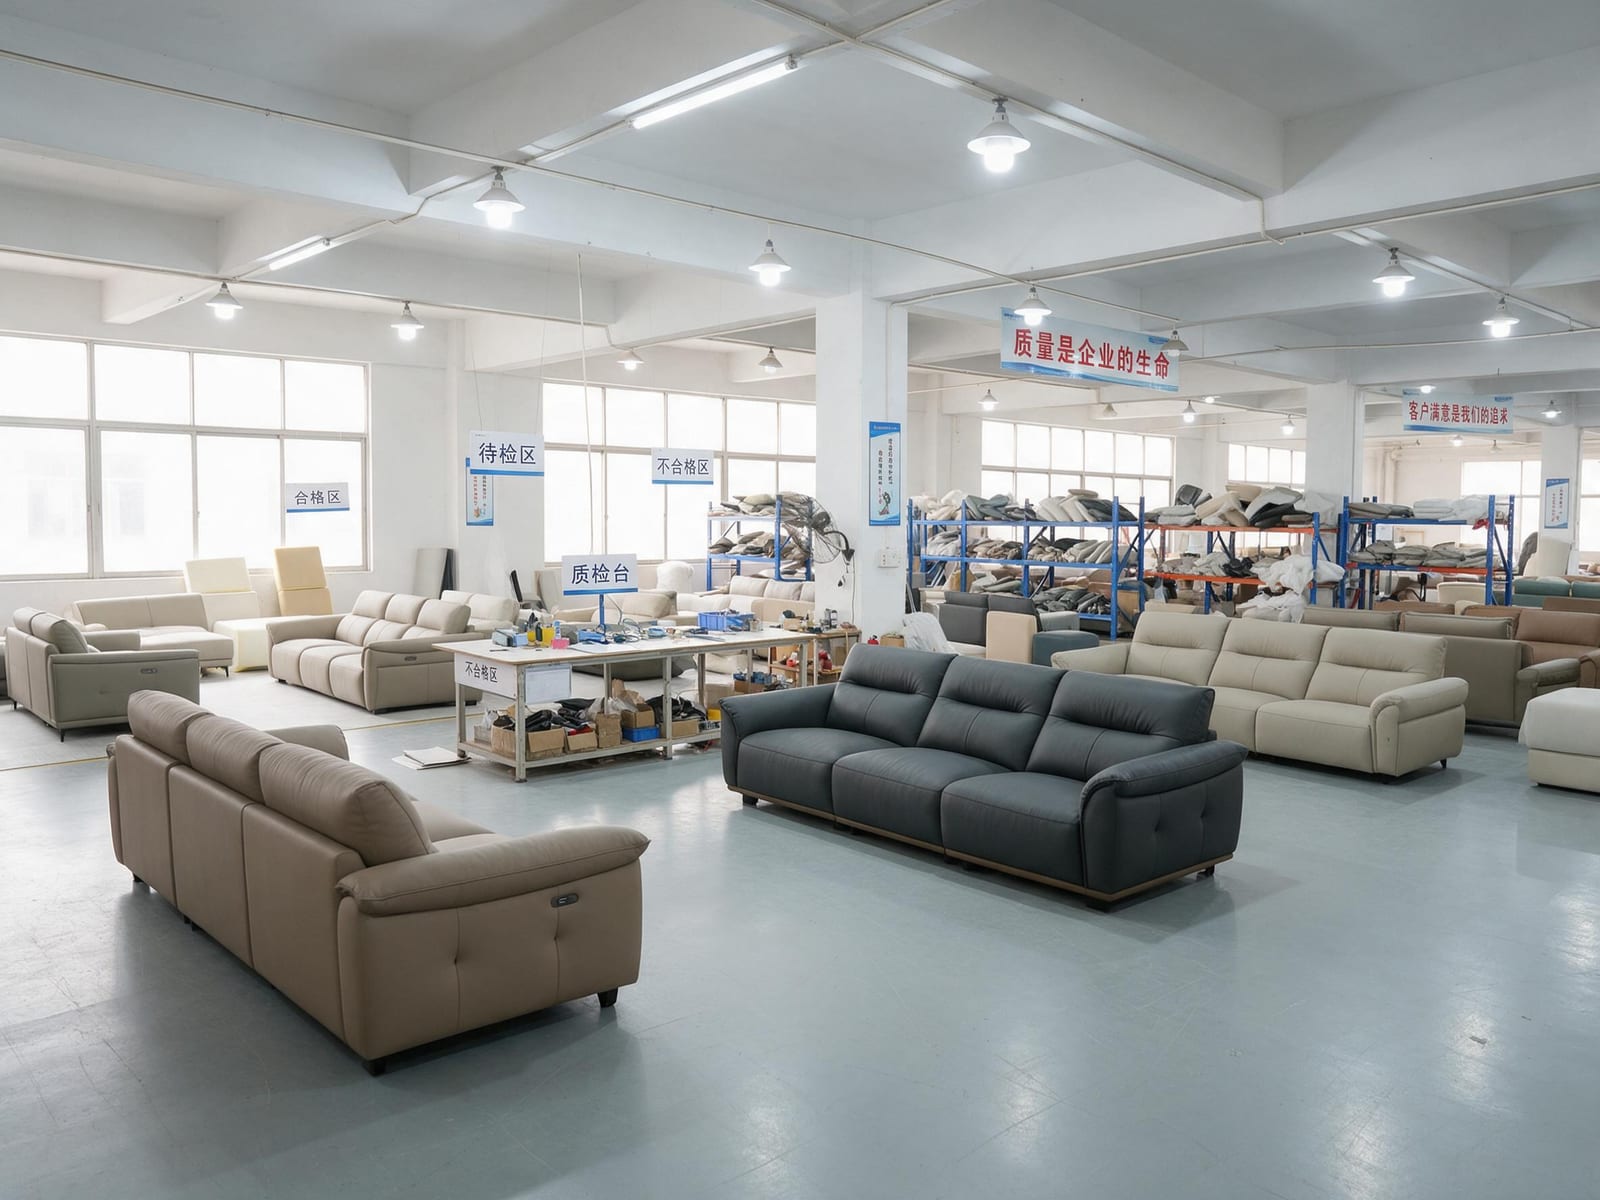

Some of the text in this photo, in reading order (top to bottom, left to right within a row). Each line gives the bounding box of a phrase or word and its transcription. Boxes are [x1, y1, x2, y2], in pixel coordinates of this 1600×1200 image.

[1014, 328, 1170, 379] 质量是企业的生命
[1408, 400, 1508, 425] 客户满意是我们的追求
[478, 442, 536, 464] 待检区
[657, 458, 709, 475] 不合格区
[295, 490, 341, 505] 合格区
[571, 563, 629, 584] 质检台
[465, 661, 498, 683] 不合格区
